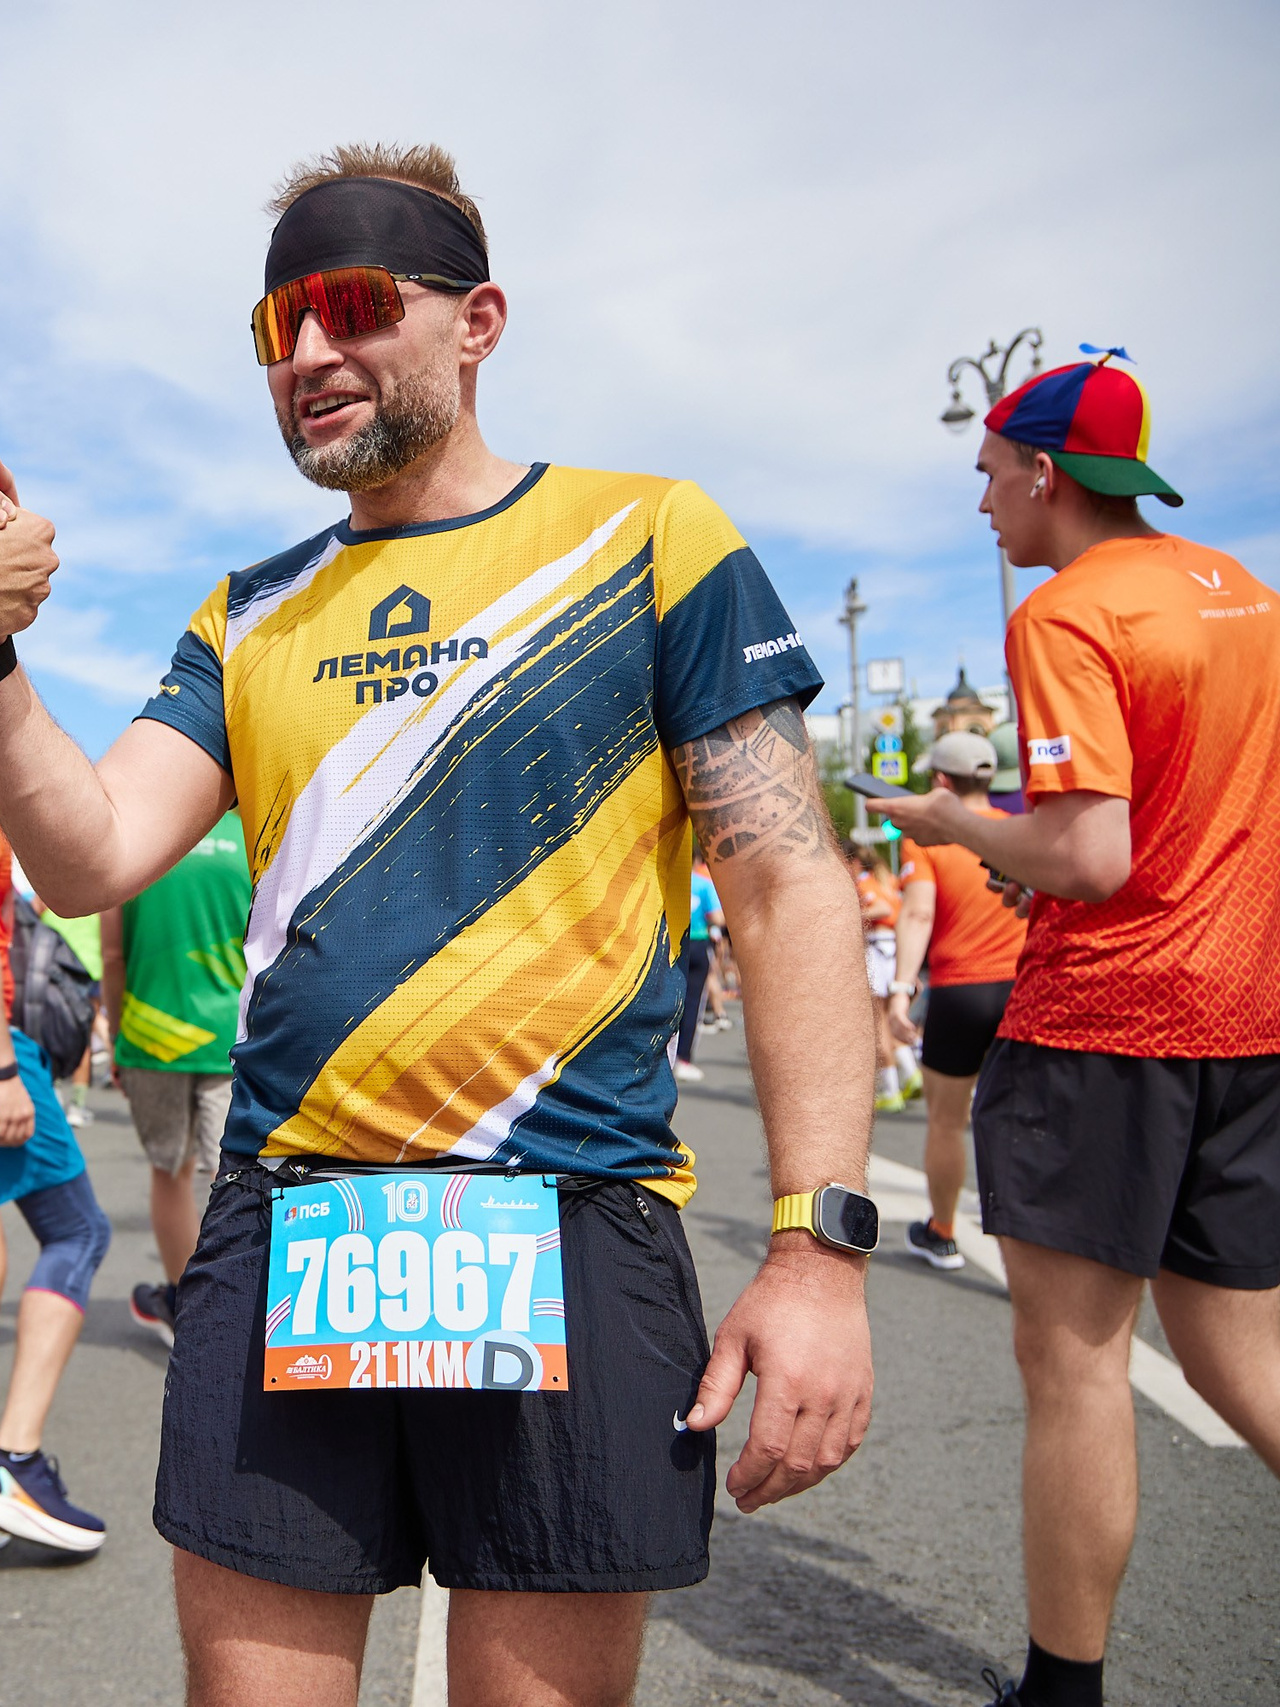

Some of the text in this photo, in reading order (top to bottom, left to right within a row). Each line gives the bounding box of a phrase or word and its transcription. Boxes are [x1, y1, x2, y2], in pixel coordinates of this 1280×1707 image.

[313, 637, 489, 683] ЛЕМАНА
[356, 671, 438, 704] ПРО
[1037, 744, 1065, 756] ПСБ
[299, 1201, 331, 1220] ПСБ
[380, 1180, 429, 1223] 10
[286, 1231, 537, 1335] 76967
[483, 1340, 534, 1391] D
